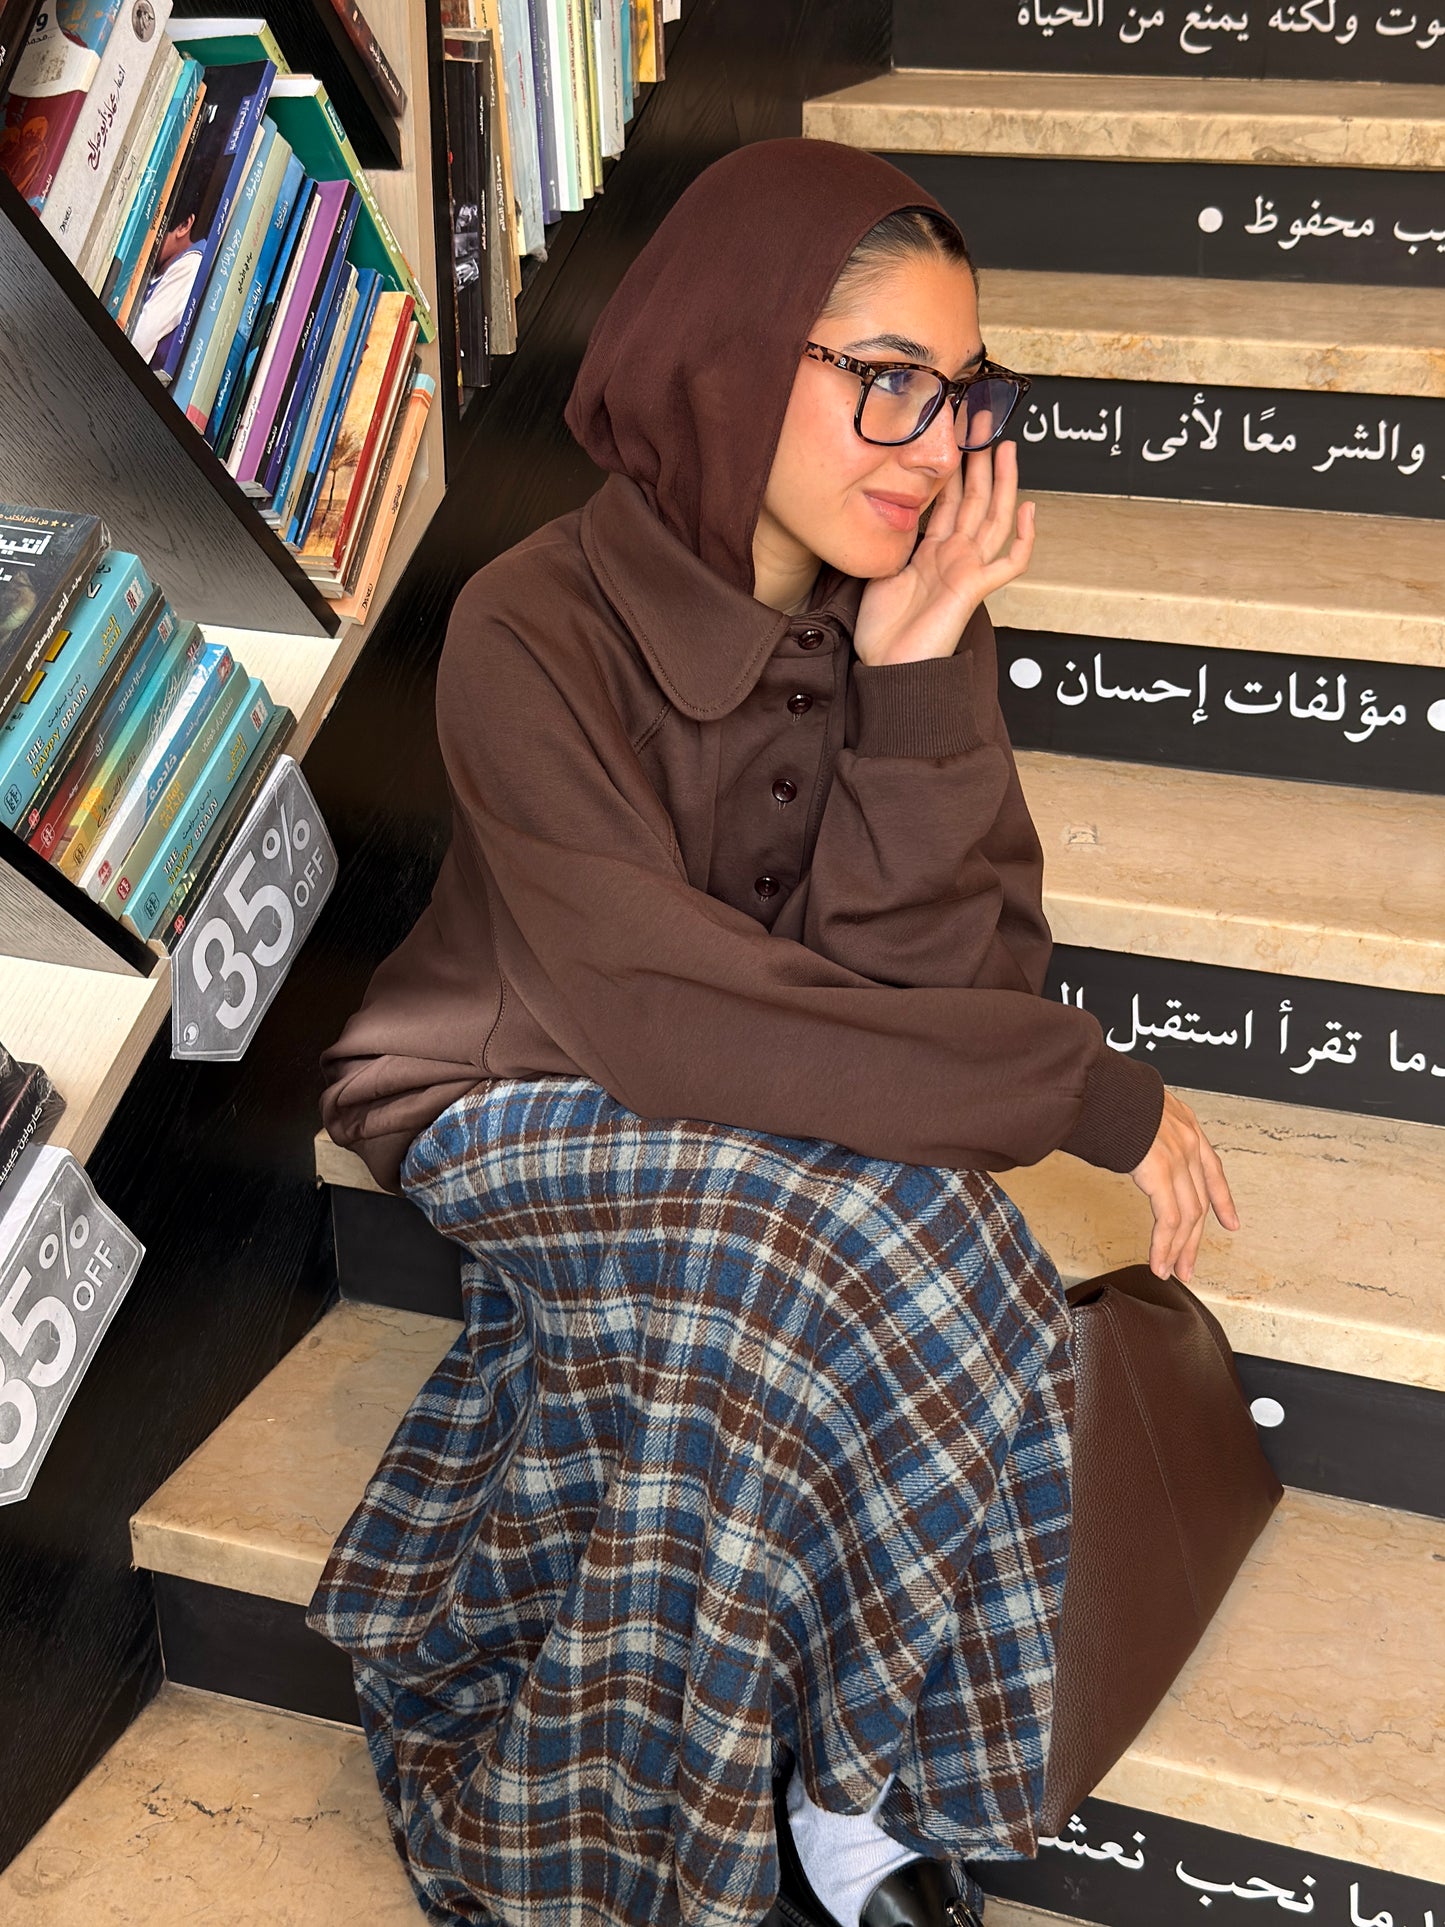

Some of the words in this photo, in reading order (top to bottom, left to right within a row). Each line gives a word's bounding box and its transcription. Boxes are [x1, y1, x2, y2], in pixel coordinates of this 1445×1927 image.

[1018, 0, 1103, 36] الحياة
[1120, 9, 1163, 42] من
[1180, 5, 1248, 53] يمنع
[1269, 0, 1357, 43] ولكنه
[1376, 9, 1445, 48] وت
[1245, 196, 1374, 249] محفوظ
[1394, 222, 1445, 254] يب
[1024, 403, 1121, 455] إنسان
[1313, 420, 1424, 474] والشر
[91, 624, 126, 669] السعيد
[95, 613, 121, 646] المخ
[1057, 653, 1208, 724] إحسان
[1225, 672, 1406, 742] مؤلفات
[23, 735, 47, 765] THE
[27, 726, 66, 779] HAPPY
[56, 682, 92, 730] BRAIN
[223, 731, 248, 762] المخ
[141, 750, 181, 802] خادمة
[220, 740, 253, 783] السعيد
[159, 845, 184, 875] THE
[163, 838, 200, 887] HAPPY
[188, 796, 223, 841] BRAIN
[294, 847, 324, 909] OFF
[192, 803, 311, 1030] 35%
[1107, 994, 1252, 1051] استقبل
[1278, 1000, 1362, 1075] تقرأ
[12, 1104, 47, 1150] كارولين
[73, 1240, 114, 1311] OFF
[1037, 1814, 1144, 1869] نعش
[1176, 1860, 1316, 1914] نحب
